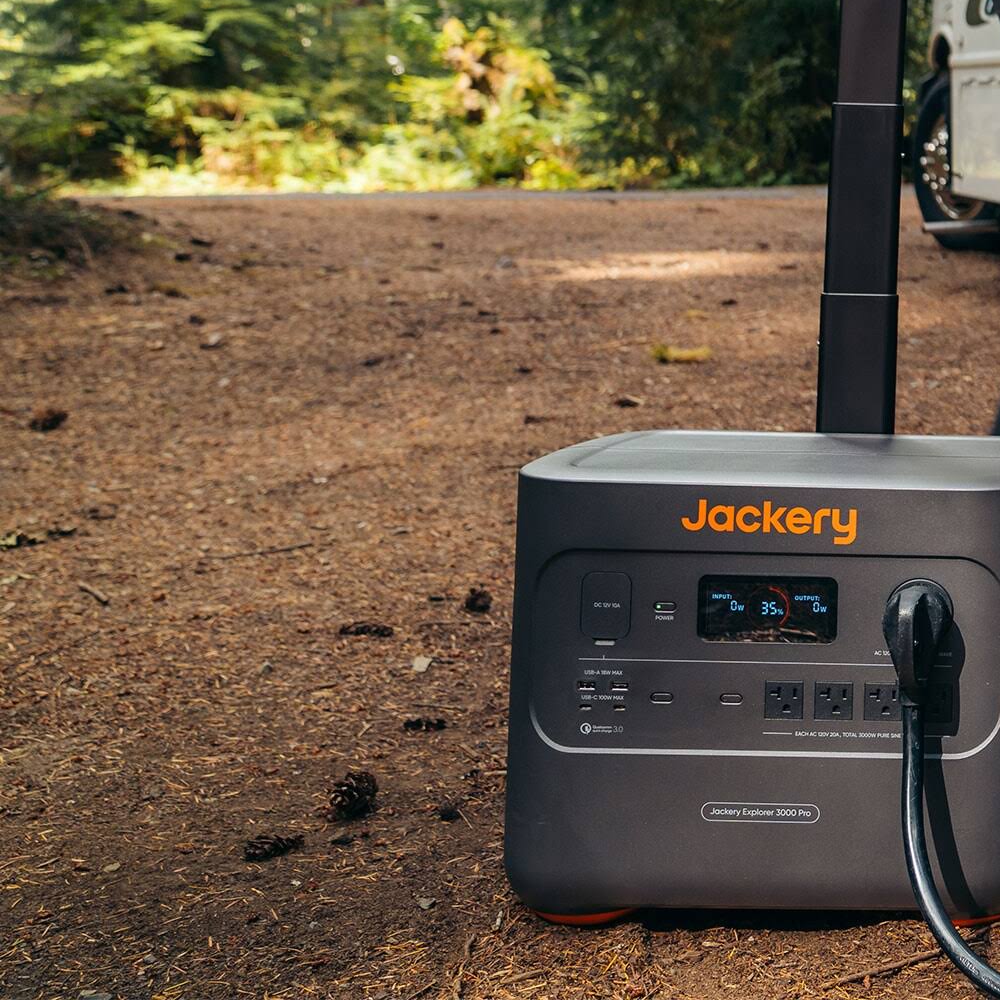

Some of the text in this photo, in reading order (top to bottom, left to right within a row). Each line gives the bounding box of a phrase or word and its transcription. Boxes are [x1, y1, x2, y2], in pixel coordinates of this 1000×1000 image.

[681, 499, 858, 545] Jackery
[761, 601, 784, 616] 35%
[709, 807, 812, 817] Jackery Explorer 3000 Pro
